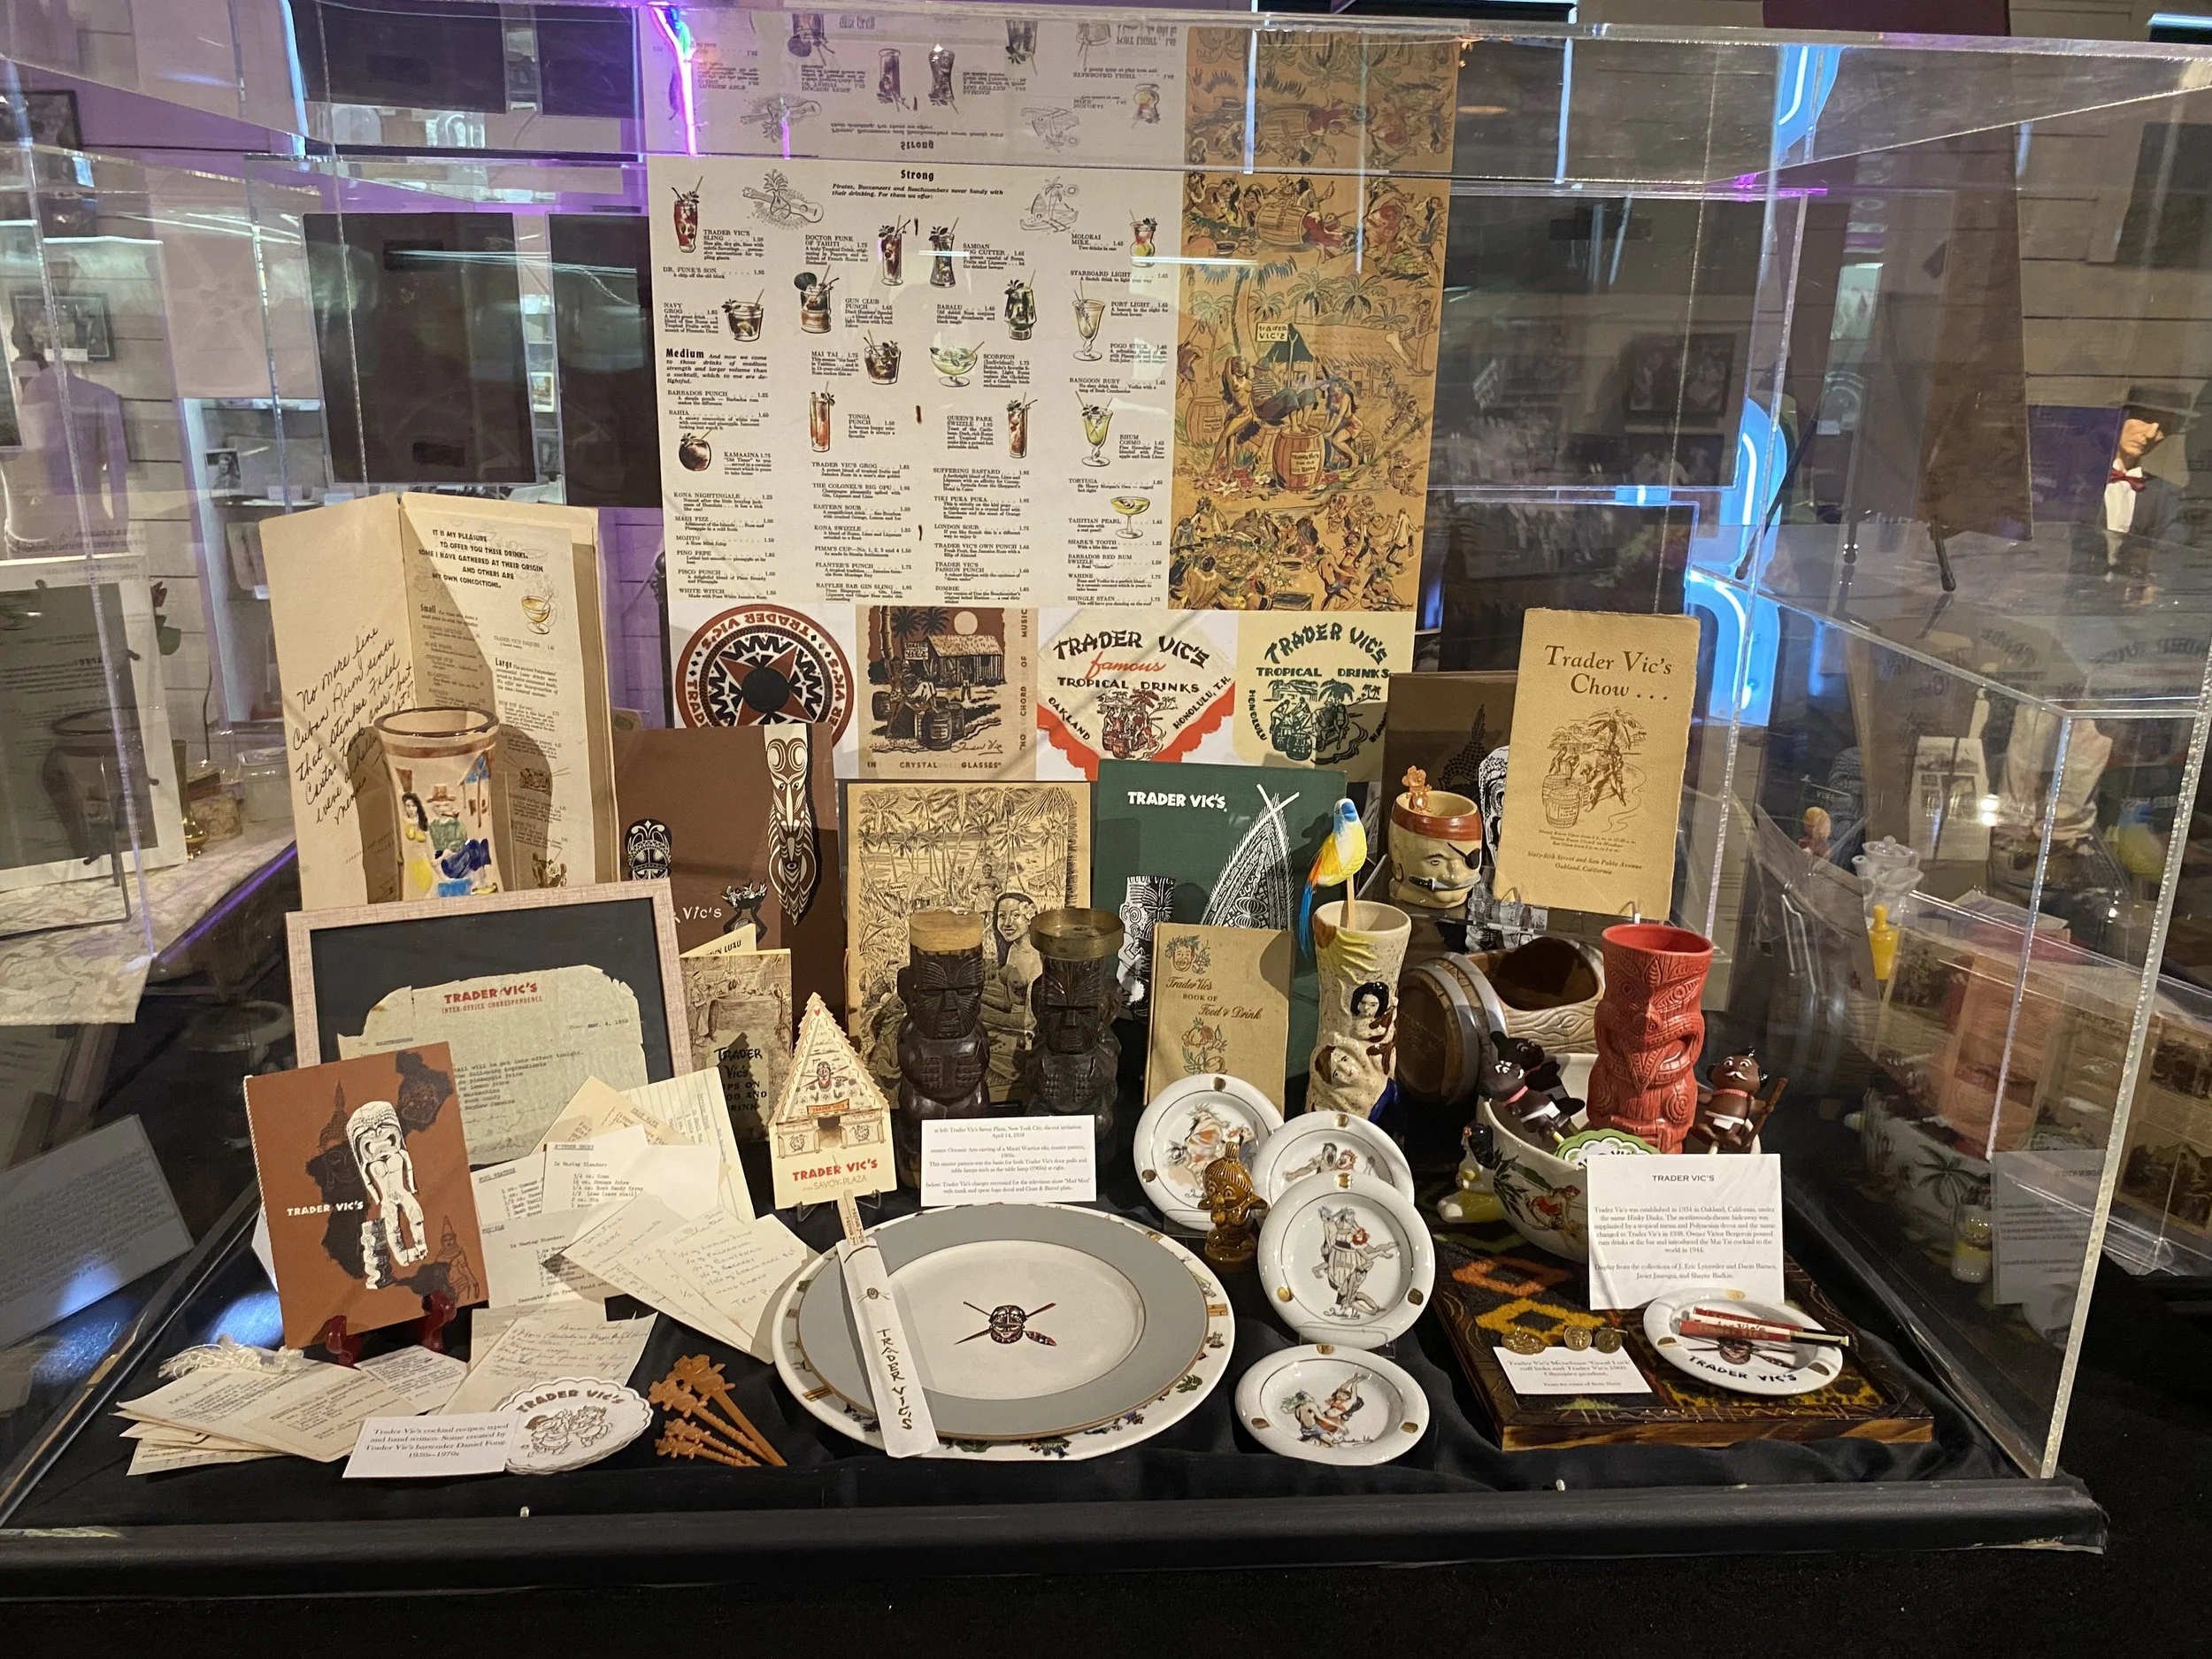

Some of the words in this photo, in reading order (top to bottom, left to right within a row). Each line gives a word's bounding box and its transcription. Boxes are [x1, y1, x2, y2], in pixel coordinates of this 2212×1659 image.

[901, 169, 934, 181] Strong
[666, 349, 704, 358] Medium
[458, 532, 488, 542] PLEASURE
[485, 547, 502, 556] THESE
[458, 554, 489, 565] GATHERED
[521, 563, 543, 572] ORIGIN
[478, 568, 500, 578] OTHERS
[420, 603, 436, 613] Small
[745, 612, 809, 636] TRADER
[1053, 629, 1143, 660] TRADER
[1158, 635, 1210, 669] VIC'S
[1263, 622, 1341, 664] TRADER
[1349, 626, 1388, 665] VIC'S
[495, 657, 512, 669] Large
[1022, 656, 1027, 667] OF
[1085, 650, 1166, 681] famous
[1545, 644, 1615, 671] Trader
[1623, 649, 1672, 676] Vic's
[1256, 667, 1322, 678] TROPICAL
[1337, 668, 1390, 679] DRINKS
[1057, 677, 1128, 690] TROPICAL
[1141, 680, 1200, 694] DRINKS
[1571, 672, 1630, 697] Chow
[1048, 696, 1091, 741] OAKLAND
[1248, 689, 1268, 741] HONOLULU
[1127, 792, 1187, 807] TRADER
[683, 906, 722, 919] Vic's
[725, 940, 741, 953] LUAU
[1166, 976, 1195, 989] Trader
[444, 988, 497, 1004] TRADER
[502, 982, 538, 995] VIC'S
[1198, 1004, 1223, 1017] Food
[1231, 1006, 1263, 1019] Drink
[714, 1048, 763, 1061] TRADER
[793, 1165, 841, 1181] TRADER
[847, 1159, 878, 1171] VIC'S
[287, 1203, 330, 1217] TRADER
[335, 1200, 364, 1212] VIC'S
[1689, 1355, 1747, 1380] TRADER
[1757, 1373, 1797, 1382] VIC'S
[877, 1328, 904, 1381] TRADER
[892, 1386, 913, 1431] VIC'S
[516, 1389, 580, 1413] TRADER
[586, 1389, 625, 1405] VIC'S
